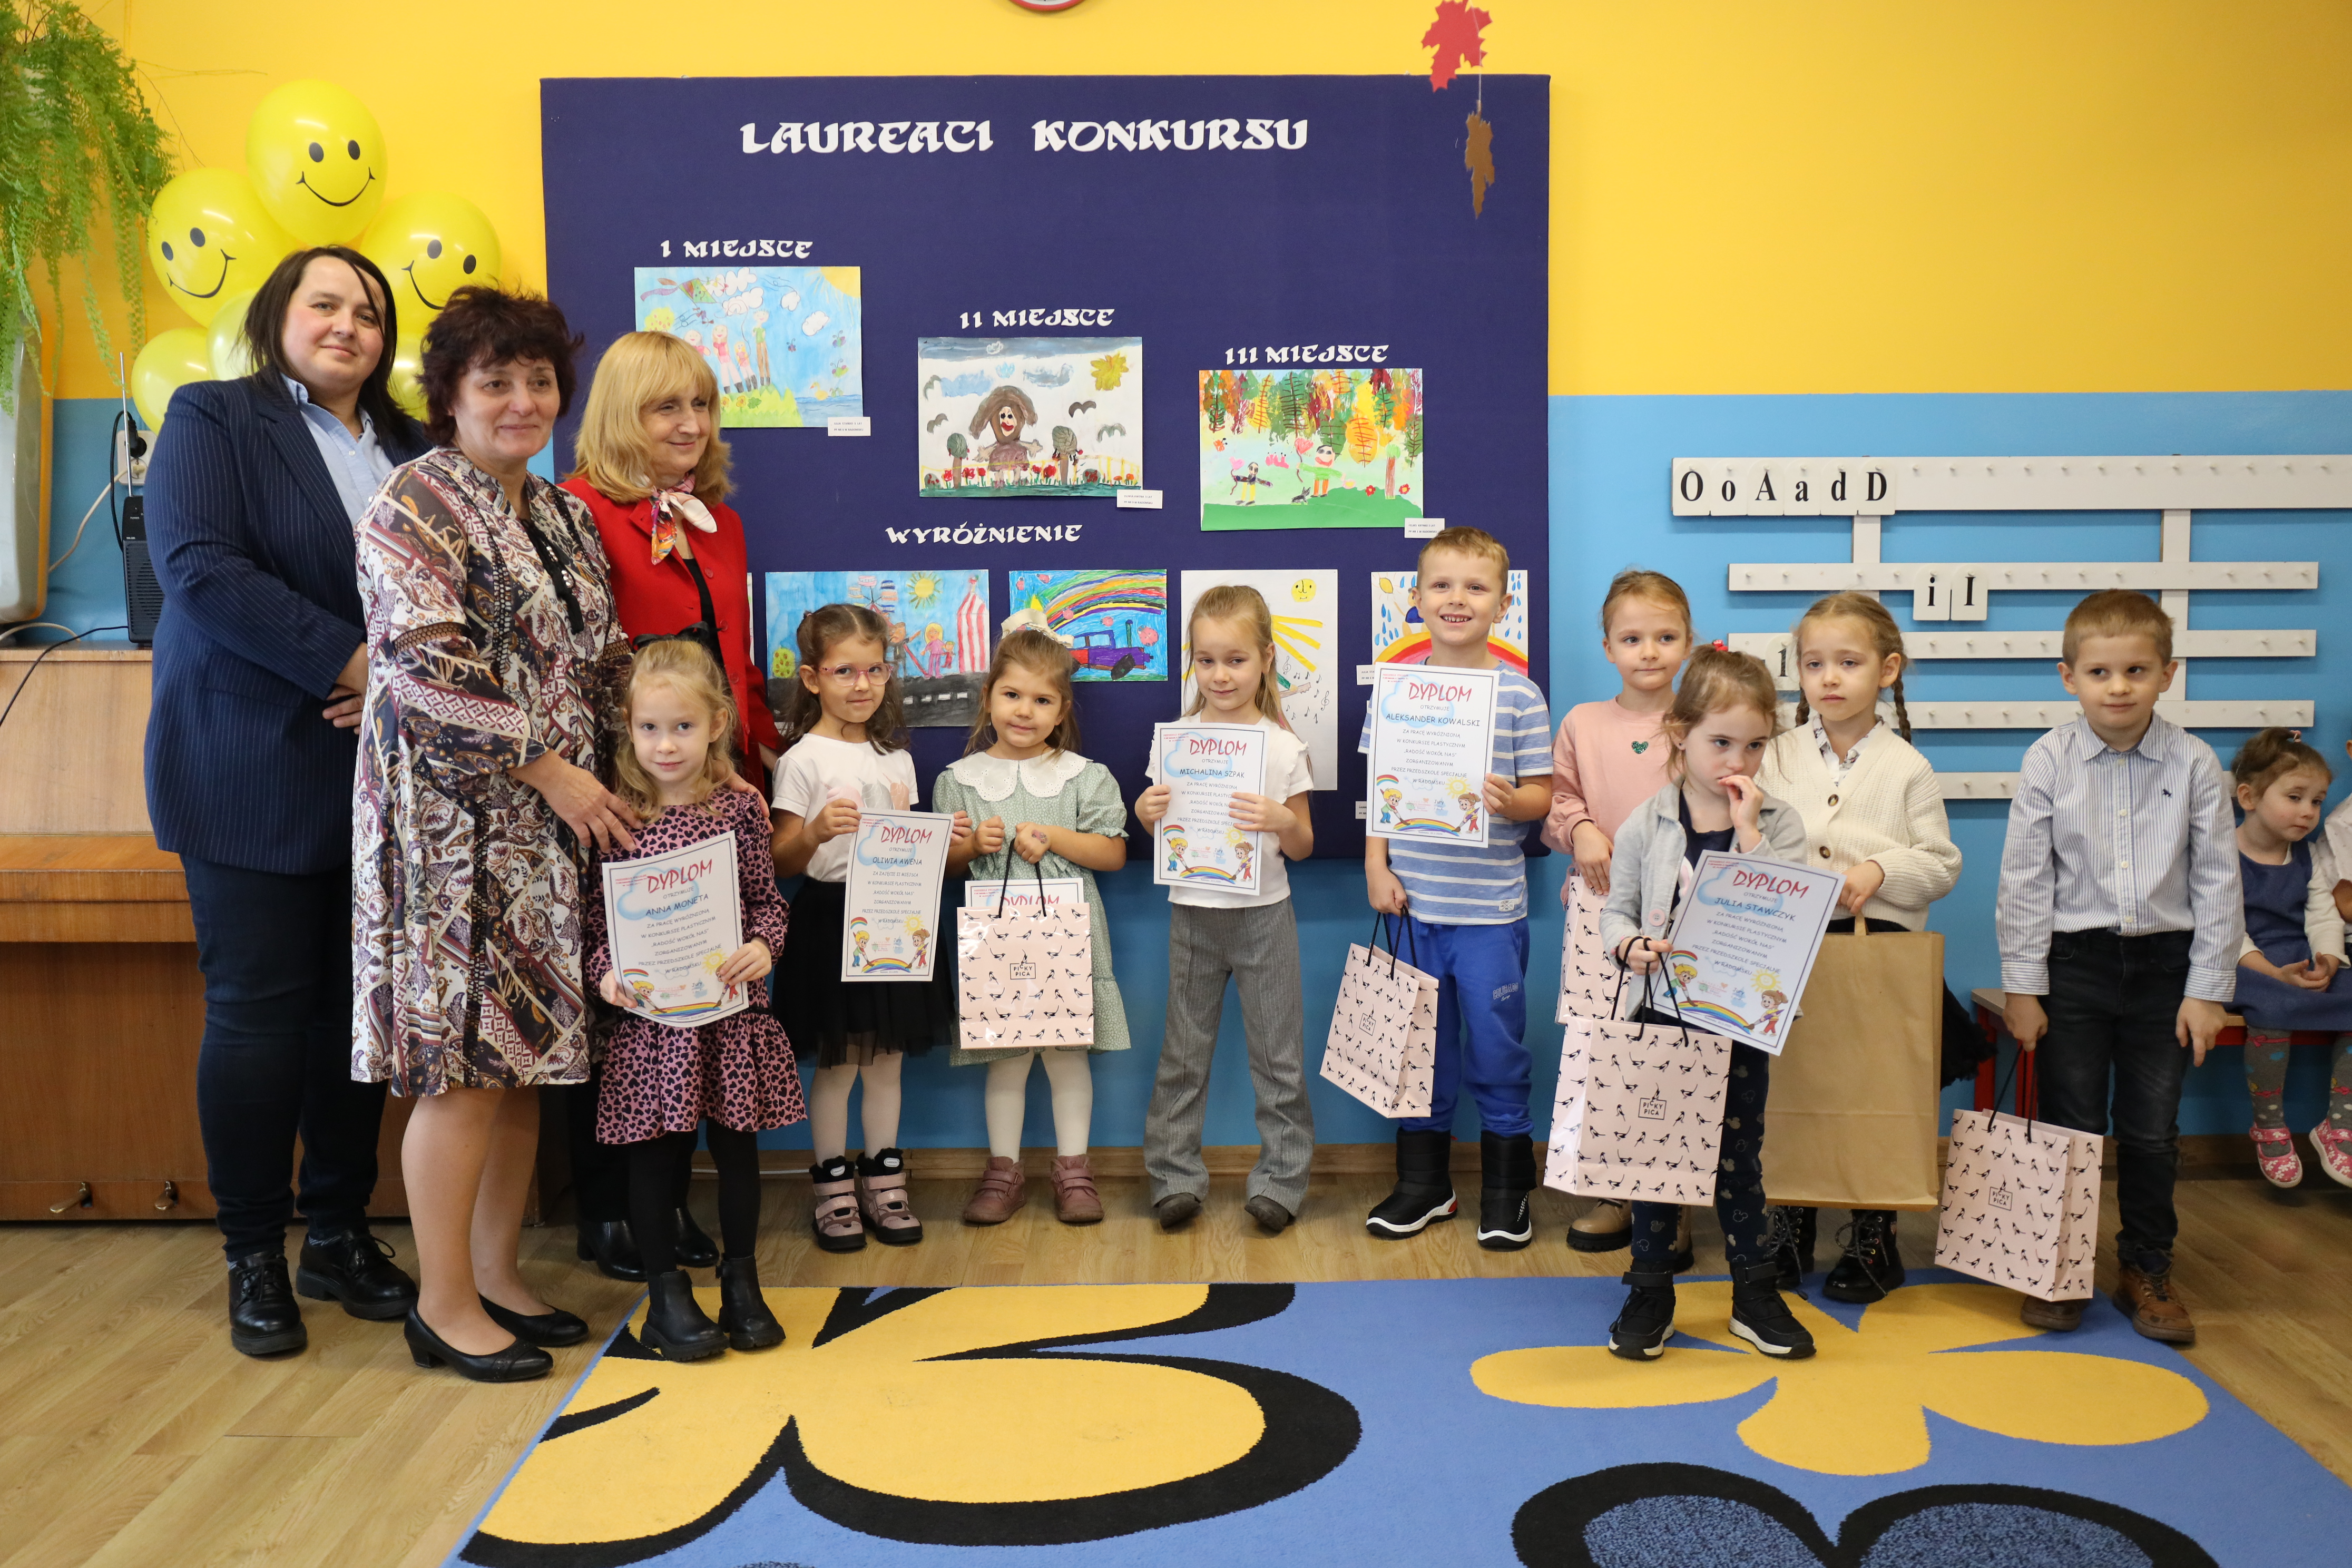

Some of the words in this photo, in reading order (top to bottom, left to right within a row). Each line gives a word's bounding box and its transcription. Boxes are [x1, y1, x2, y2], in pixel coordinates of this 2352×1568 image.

[740, 121, 993, 153] LAUREACI
[1032, 119, 1307, 151] KONKURSU
[683, 240, 812, 258] MIEJSCE
[993, 309, 1114, 327] MIEJSCE
[1265, 345, 1389, 362] MIEJSCE
[1680, 471, 1704, 502] O
[1755, 472, 1777, 501] A
[1795, 481, 1809, 502] a
[1830, 471, 1847, 501] d
[1865, 471, 1887, 501] D
[885, 522, 1082, 544] WYRÓŻNIENIE
[1408, 682, 1472, 702] DYPLOM
[1386, 713, 1436, 723] ALEKSANDER
[1438, 717, 1480, 727] KOWALSKI
[1190, 738, 1247, 756] DYPLOM
[881, 826, 933, 844] DYPLOM
[647, 858, 712, 894] DYPLOM
[1732, 869, 1809, 899] DYPLOM
[663, 886, 694, 899] OTRZYMUJE
[1743, 891, 1778, 903] OTRZYMUJE
[645, 905, 671, 916] ANNA
[674, 894, 709, 910] MONETA
[1715, 897, 1742, 907] JULIA
[1745, 904, 1796, 922] STAWCZYK
[648, 928, 680, 938] KONKURSIE
[681, 916, 716, 931] PLASTYCZNYM
[1714, 920, 1747, 932] KONKURSIE
[1747, 928, 1787, 943] PLASTYCZNYM
[655, 939, 707, 956] ZORGANIZOWANYM
[657, 953, 694, 965] PRZEDSZKOLE
[695, 944, 722, 957] SPECJALNE
[1712, 939, 1768, 959] ZORGANIZOWANYM
[672, 962, 701, 972] RADOMSKU
[1692, 944, 1710, 952] PRZEZ
[1710, 949, 1749, 964] PRZEDSZKOLE
[1750, 961, 1781, 974] SPECJALNE
[1721, 962, 1752, 975] RADOMSKU
[1493, 982, 1518, 1000] COLORADO
[1362, 1023, 1370, 1031] PICA
[1363, 1016, 1374, 1026] PICKY
[1643, 1100, 1663, 1109] PICKY
[1993, 1190, 2009, 1200] PICKY
